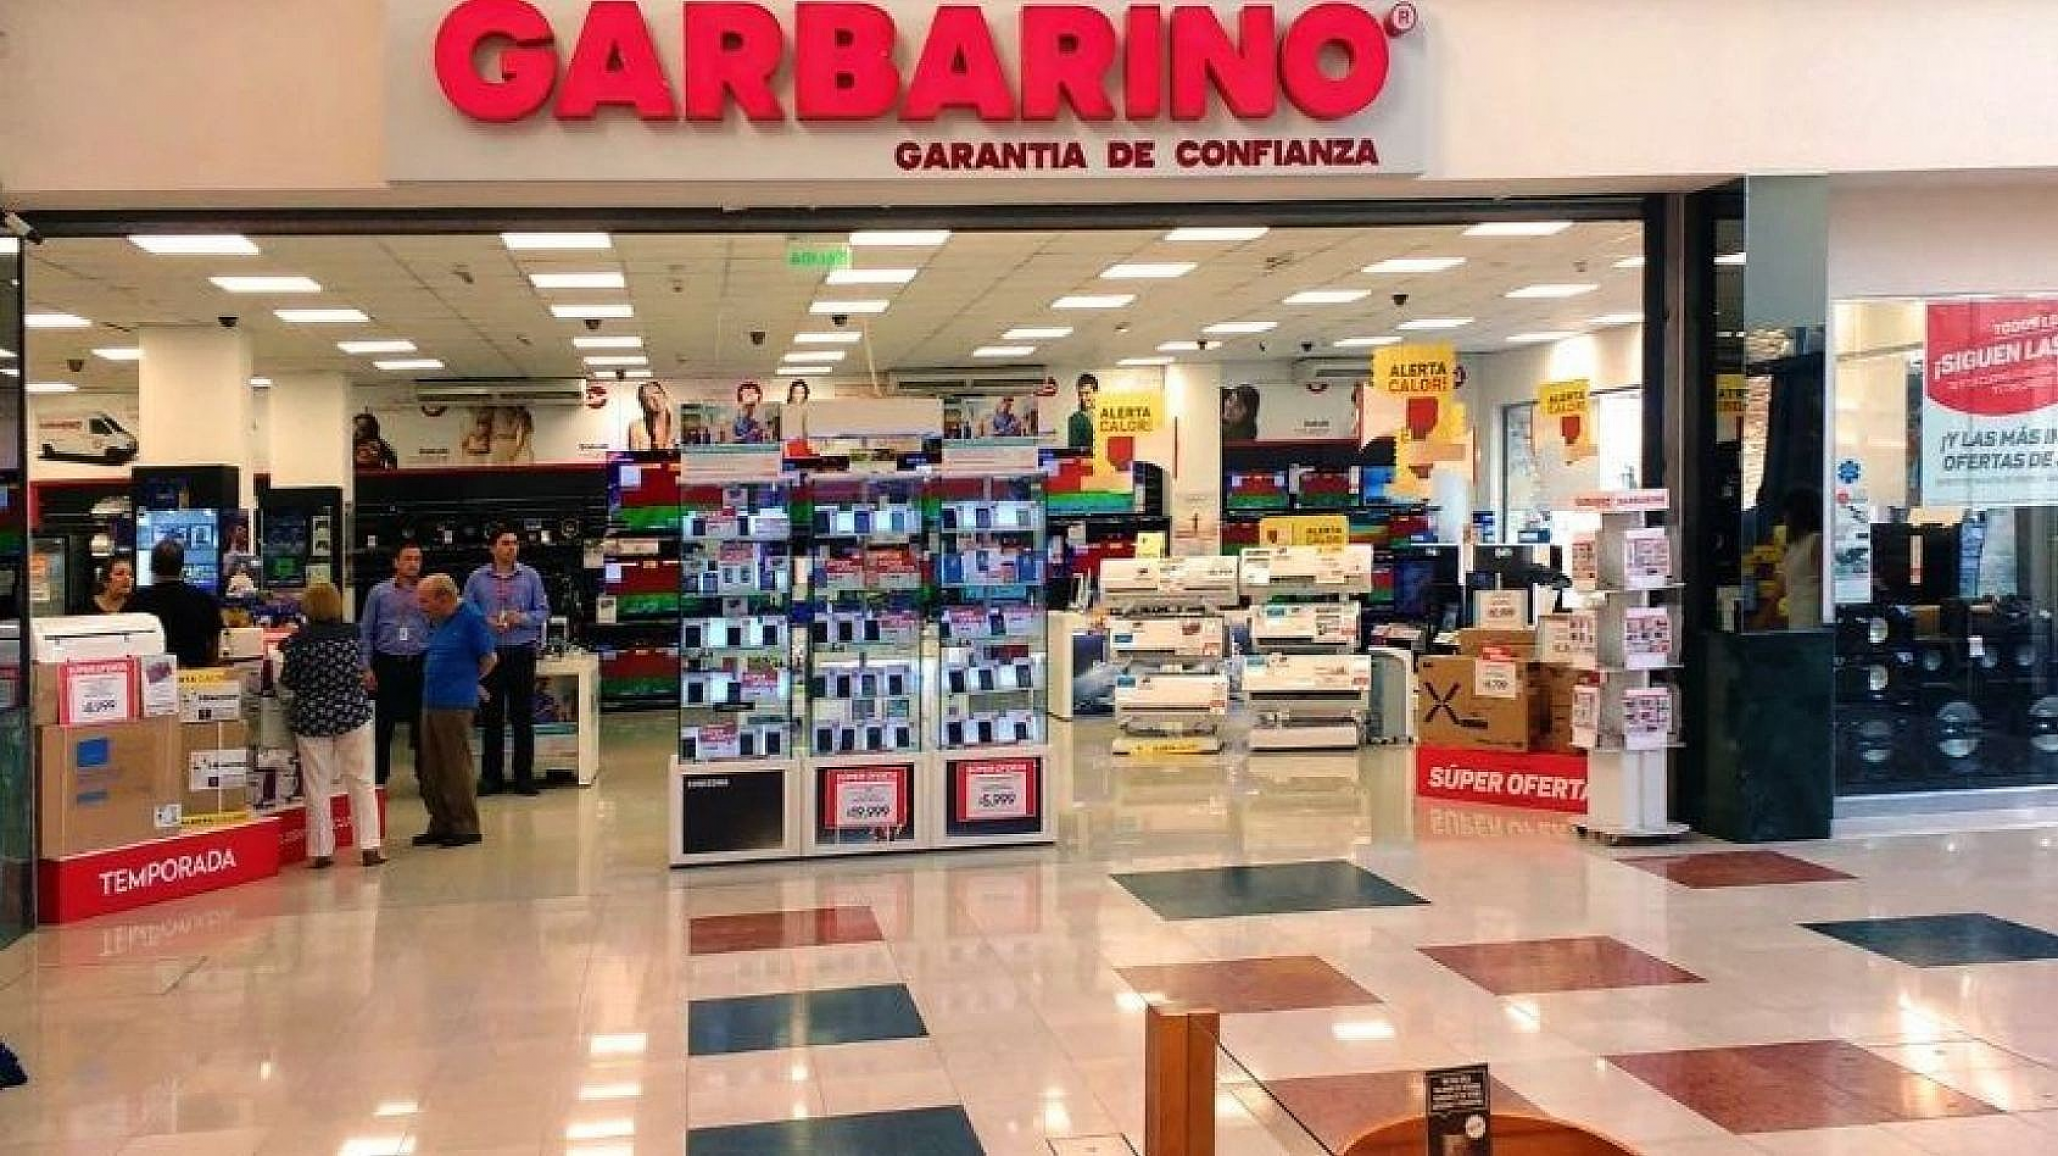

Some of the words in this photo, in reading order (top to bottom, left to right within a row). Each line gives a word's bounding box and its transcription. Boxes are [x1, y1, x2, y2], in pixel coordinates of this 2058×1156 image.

[434, 0, 1390, 122] GARBARINO
[895, 141, 1087, 171] GARANTIA
[1108, 141, 1154, 169] DE
[1174, 138, 1379, 168] CONFIANZA
[1388, 361, 1447, 378] ALERTA
[1934, 341, 2020, 381] ¡SIGUEN
[1100, 406, 1151, 418] ALERTA
[1962, 431, 1996, 447] LAS
[1944, 453, 2026, 472] OFERTAS
[2029, 450, 2053, 468] DE
[1429, 764, 1502, 793] SÚPER
[99, 849, 237, 896] TEMPORADA
